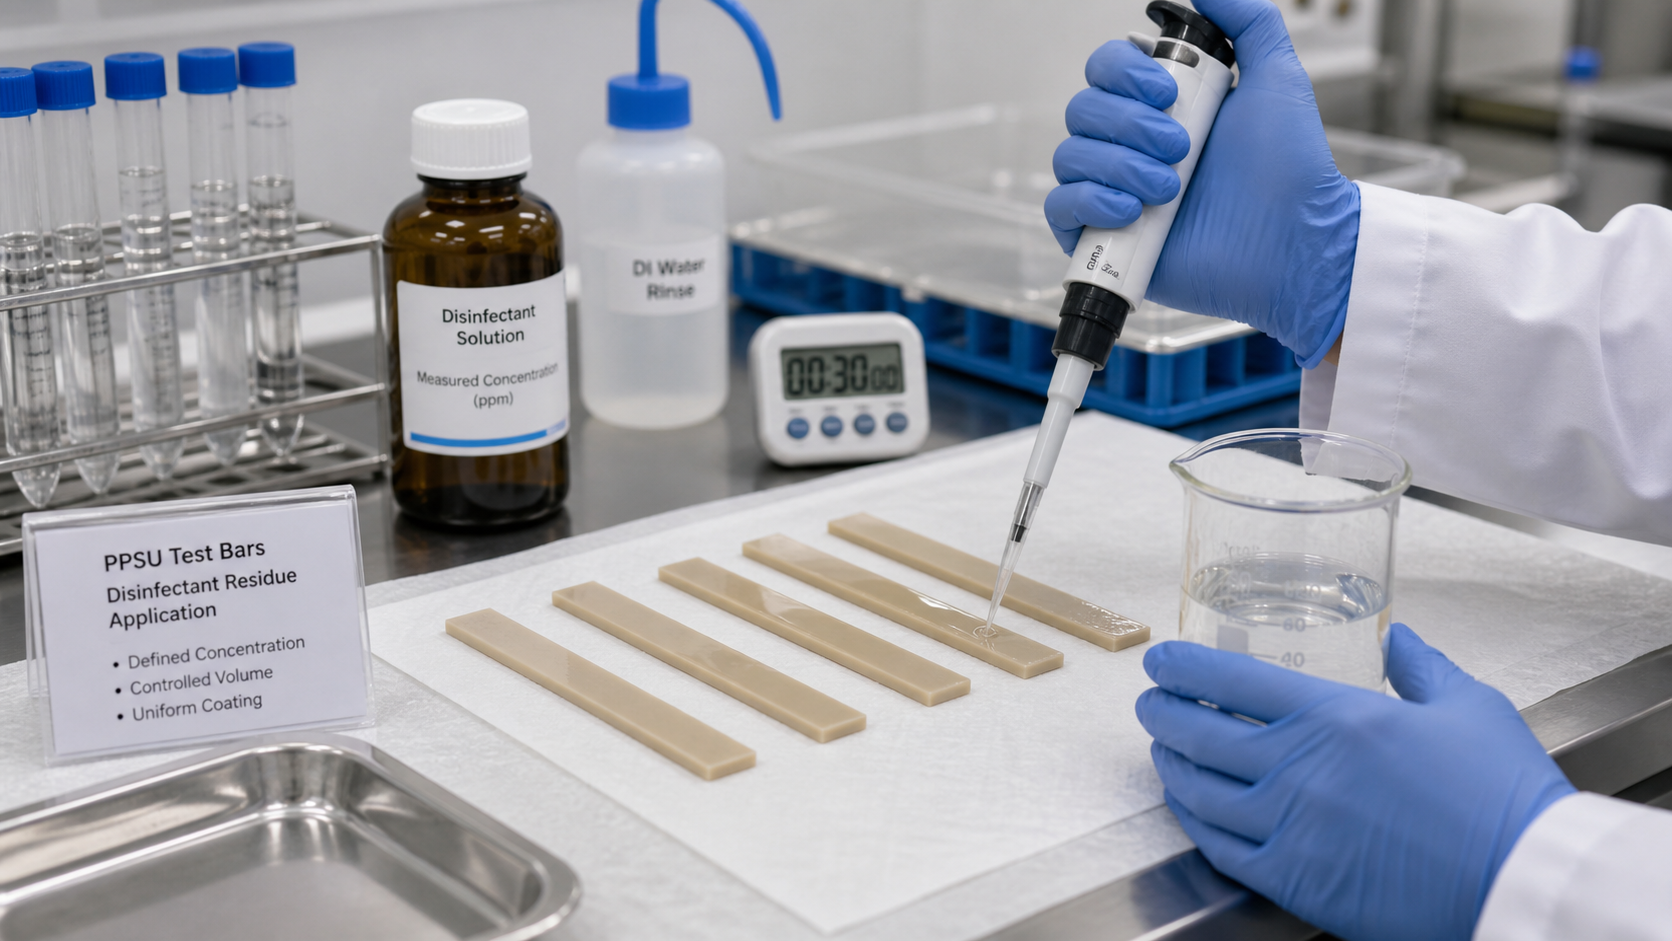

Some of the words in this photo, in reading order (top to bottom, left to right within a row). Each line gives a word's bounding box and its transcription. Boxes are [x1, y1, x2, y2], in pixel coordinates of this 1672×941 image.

[657, 259, 705, 276] Water
[646, 283, 696, 300] Rinse
[442, 304, 536, 324] Disinfectant
[456, 329, 525, 346] Solution
[416, 370, 479, 388] Measured
[483, 362, 559, 387] Concentration
[473, 391, 514, 410] (ppm)
[104, 549, 163, 573] PPSU
[169, 545, 214, 566] Test
[219, 540, 266, 560] Bars
[106, 576, 220, 604] Disinfectant
[224, 568, 298, 591] Residue
[109, 602, 217, 631] Application
[128, 648, 191, 670] Defined
[195, 636, 306, 662] Concentration
[130, 672, 211, 696] Controlled
[215, 665, 274, 686] Volume
[132, 700, 197, 722] Uniform
[201, 693, 263, 713] Coating
